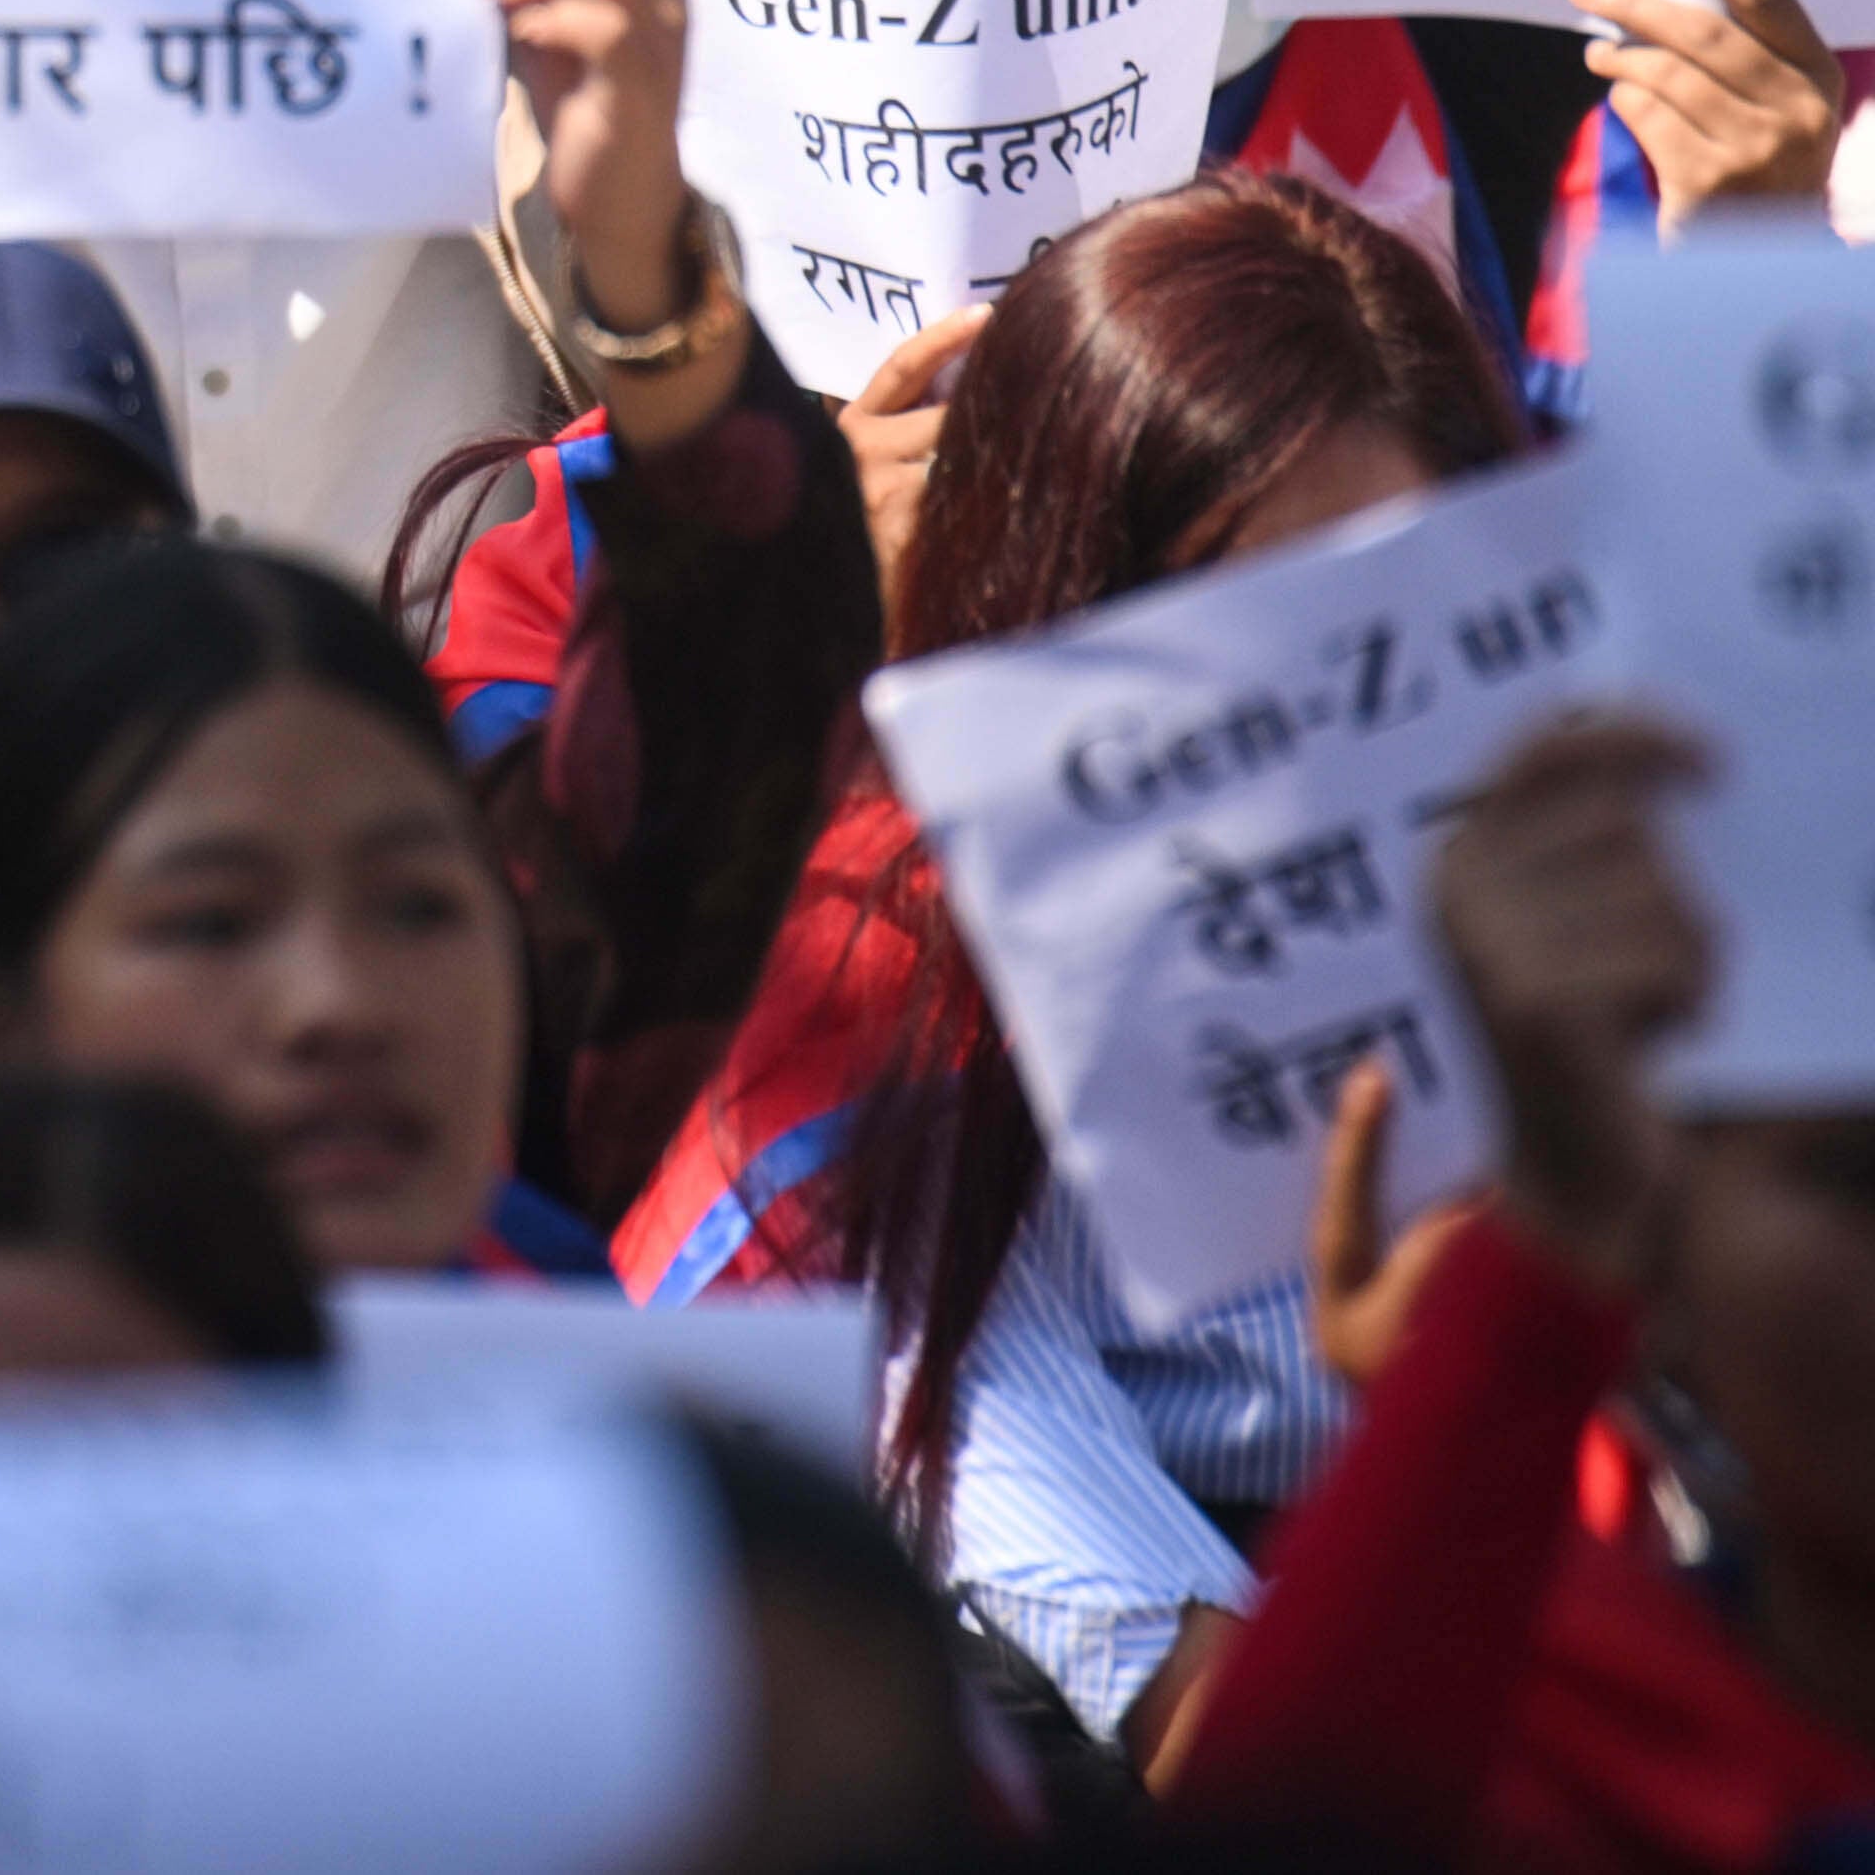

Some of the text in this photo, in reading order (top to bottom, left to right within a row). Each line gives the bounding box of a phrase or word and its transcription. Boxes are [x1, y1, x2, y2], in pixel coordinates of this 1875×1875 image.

[404, 33, 433, 116] !
[795, 61, 1148, 195] शहीदहरुको
[791, 242, 926, 336] रगत
[1057, 612, 1439, 822] Gen-Z
